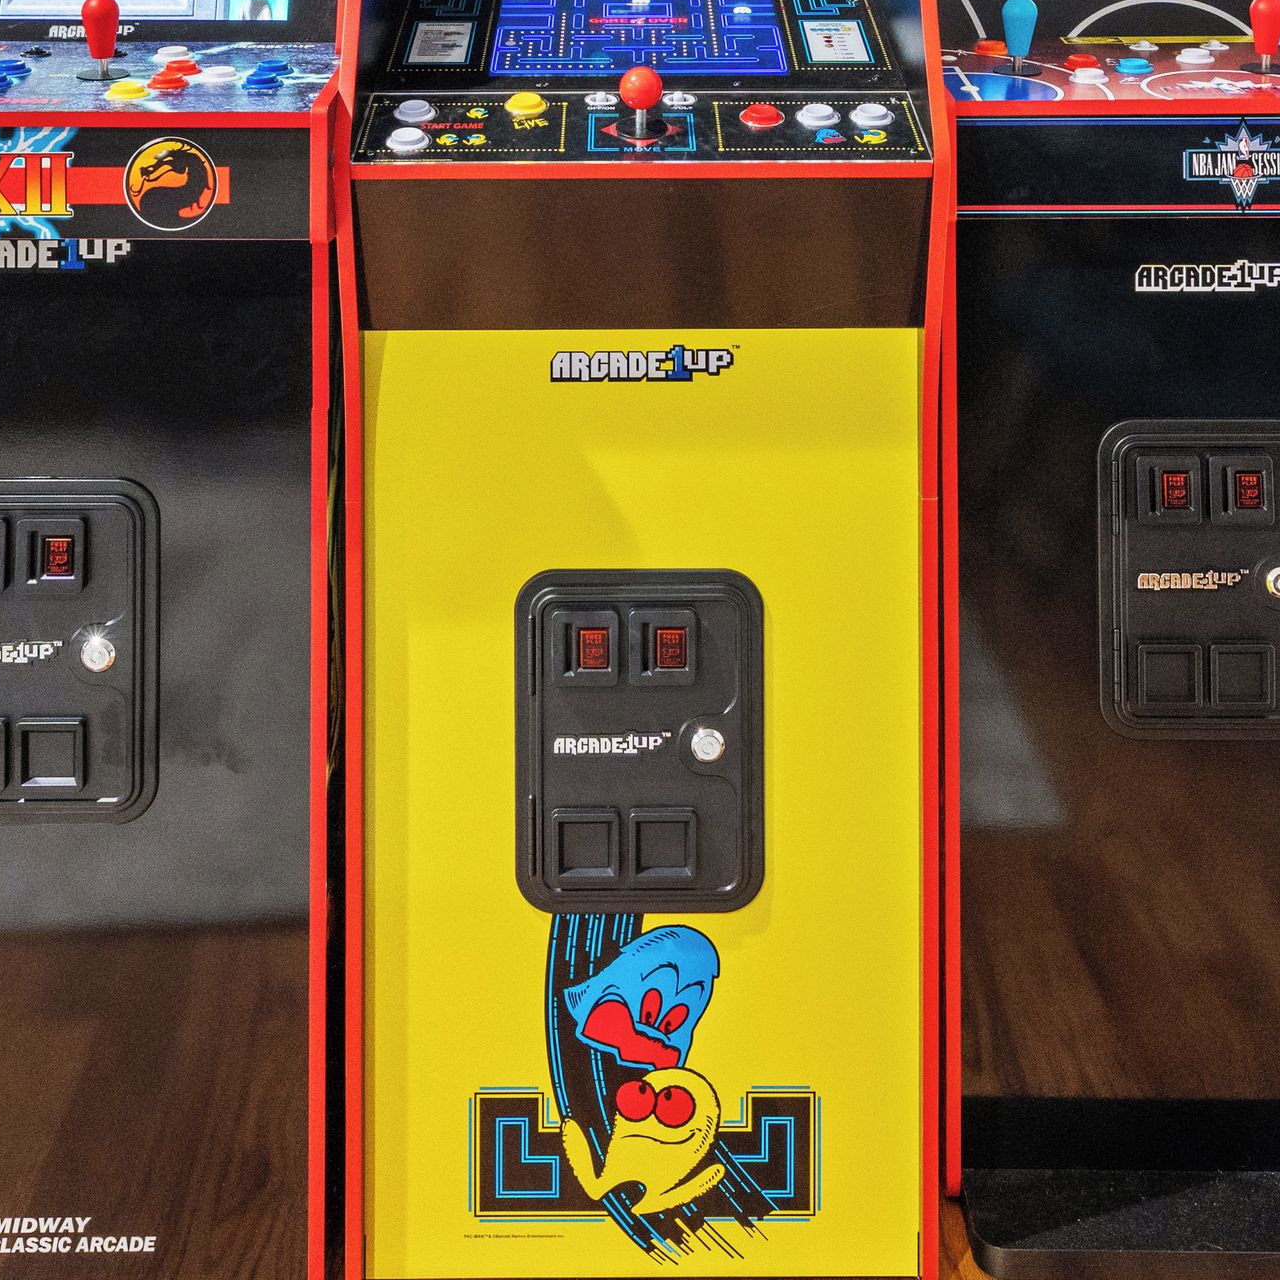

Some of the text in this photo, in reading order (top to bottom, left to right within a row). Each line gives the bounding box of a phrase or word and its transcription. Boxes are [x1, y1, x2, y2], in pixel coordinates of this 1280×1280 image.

[421, 122, 484, 130] START GAME
[1192, 153, 1214, 176] NBA
[1215, 153, 1237, 176] JAM
[75, 1236, 157, 1252] ARCADE
